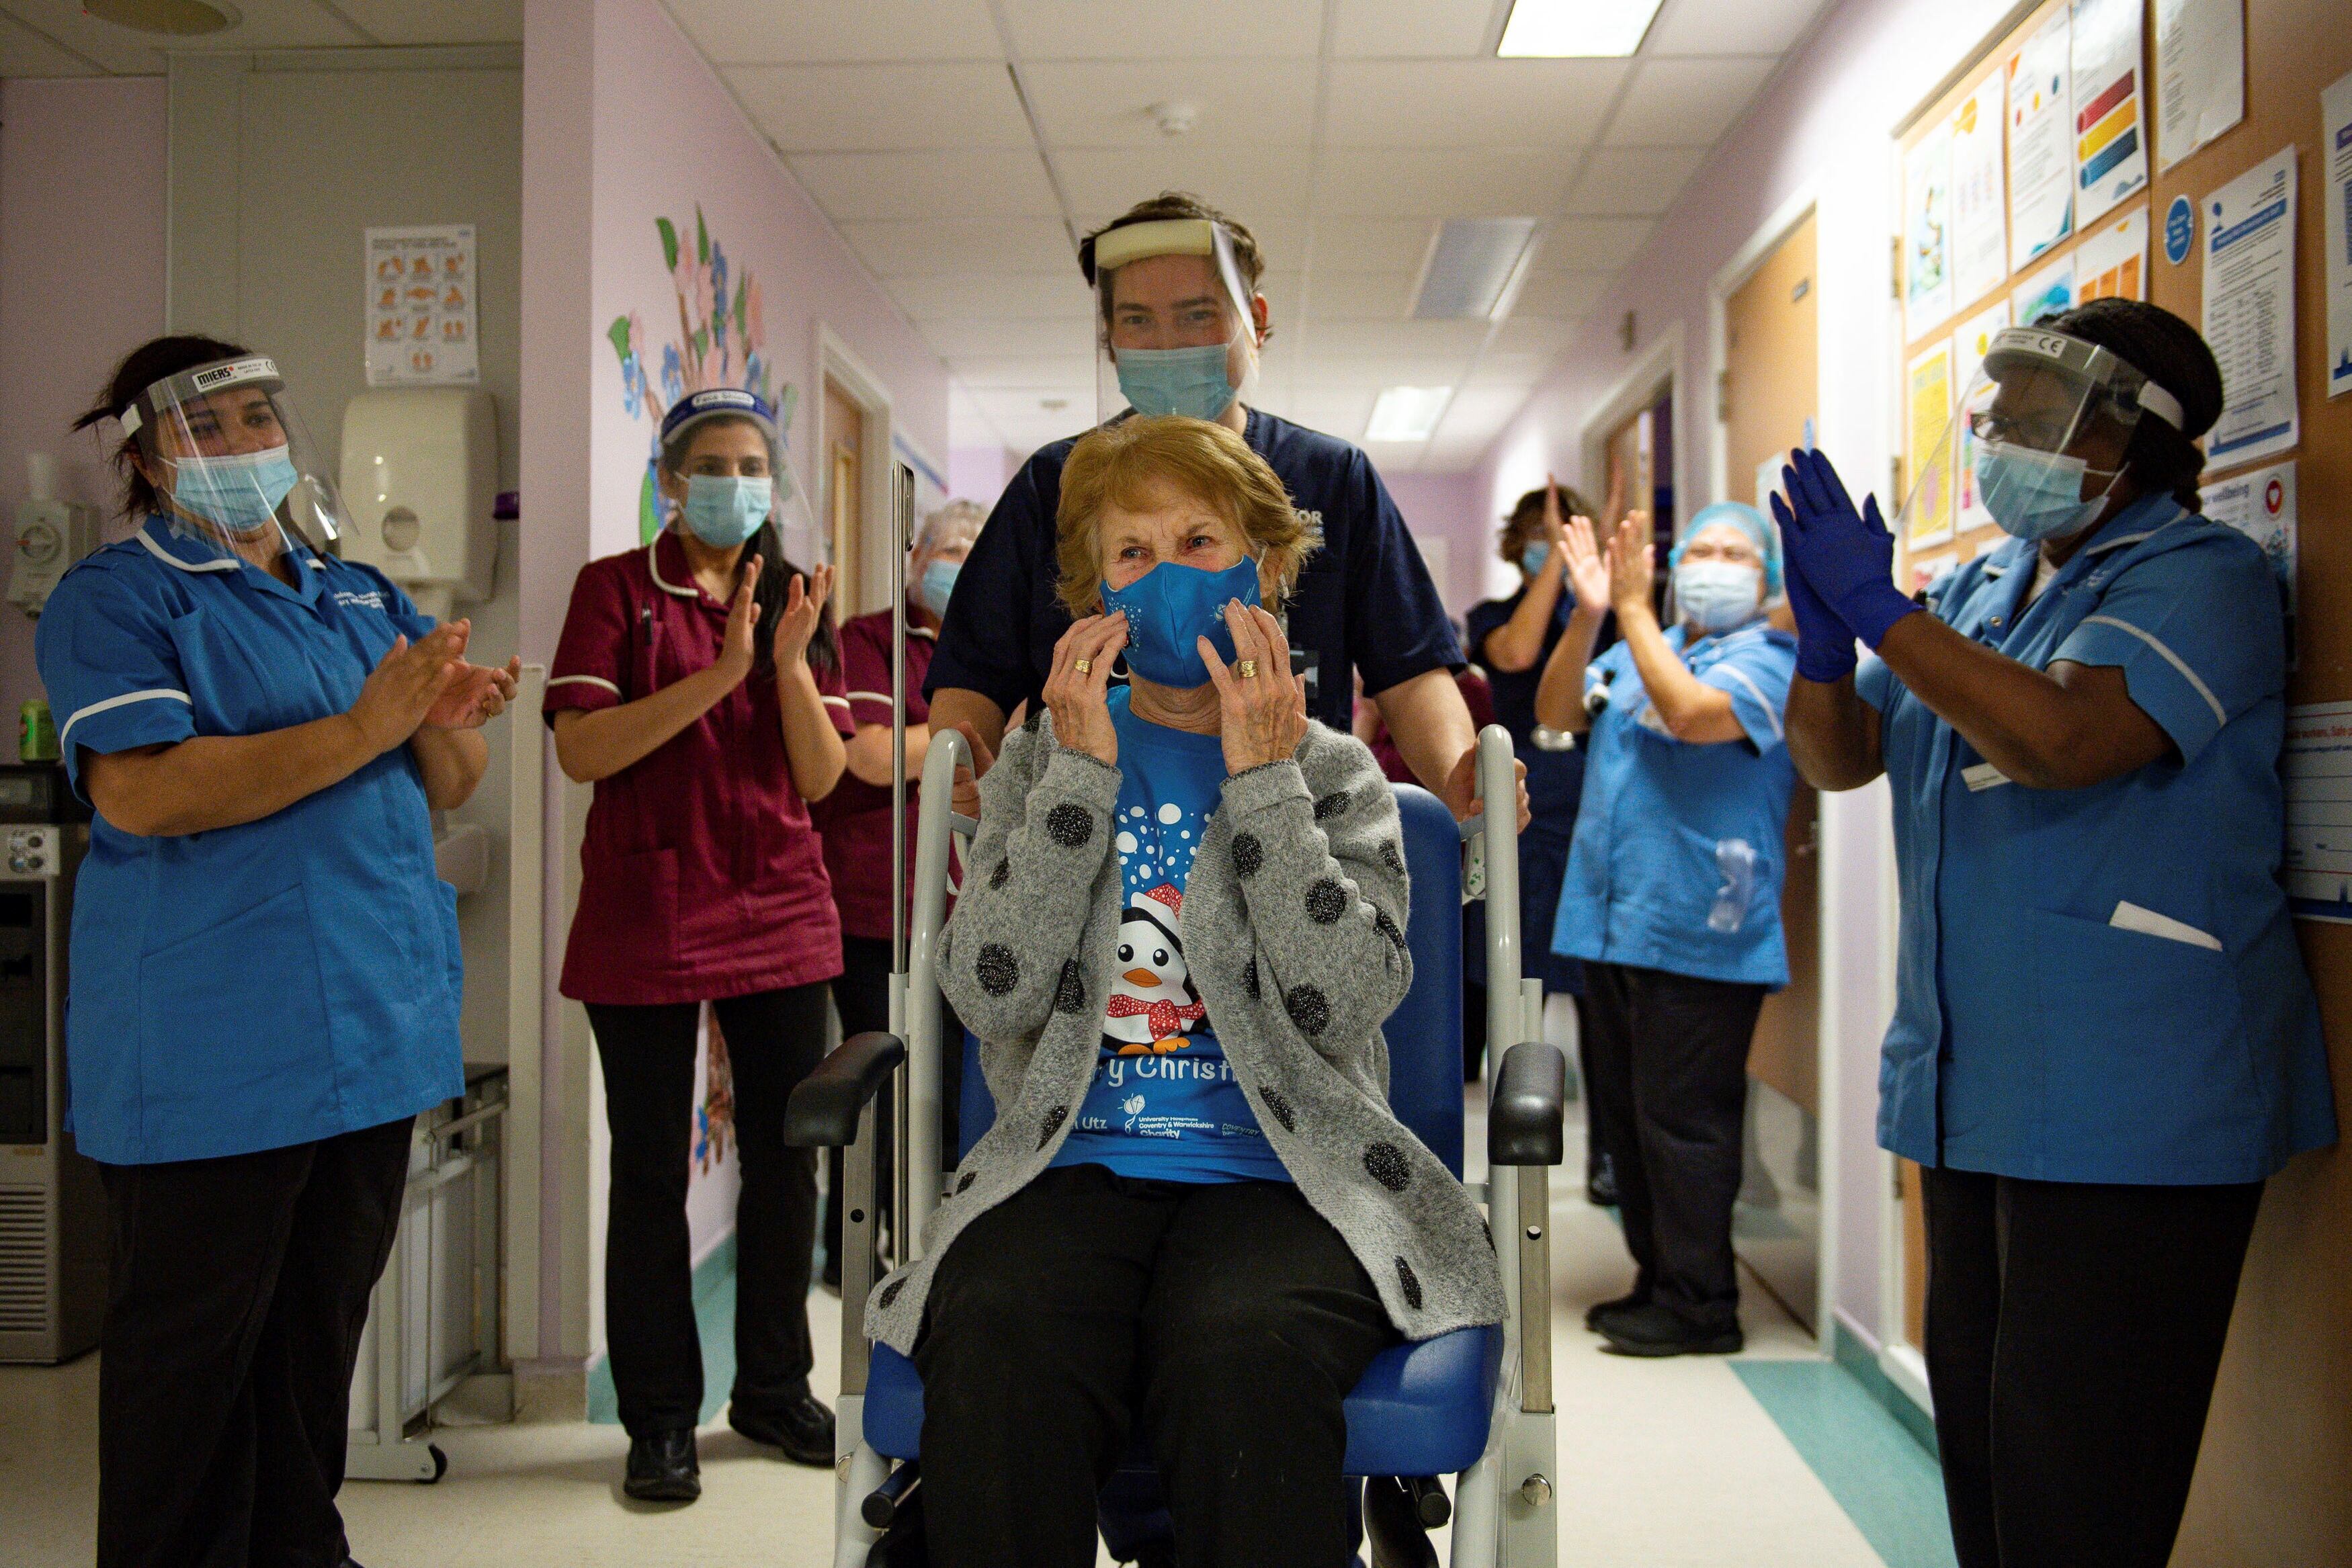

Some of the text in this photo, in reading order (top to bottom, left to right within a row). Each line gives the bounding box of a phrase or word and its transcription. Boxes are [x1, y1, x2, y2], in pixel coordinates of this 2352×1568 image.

[197, 367, 231, 386] MIERS
[1136, 1053, 1238, 1082] Christ
[1082, 1117, 1108, 1129] Utz
[1173, 1121, 1214, 1129] Warwickshire
[1140, 1128, 1180, 1139] Charity
[1222, 1123, 1260, 1136] COVENTRY
